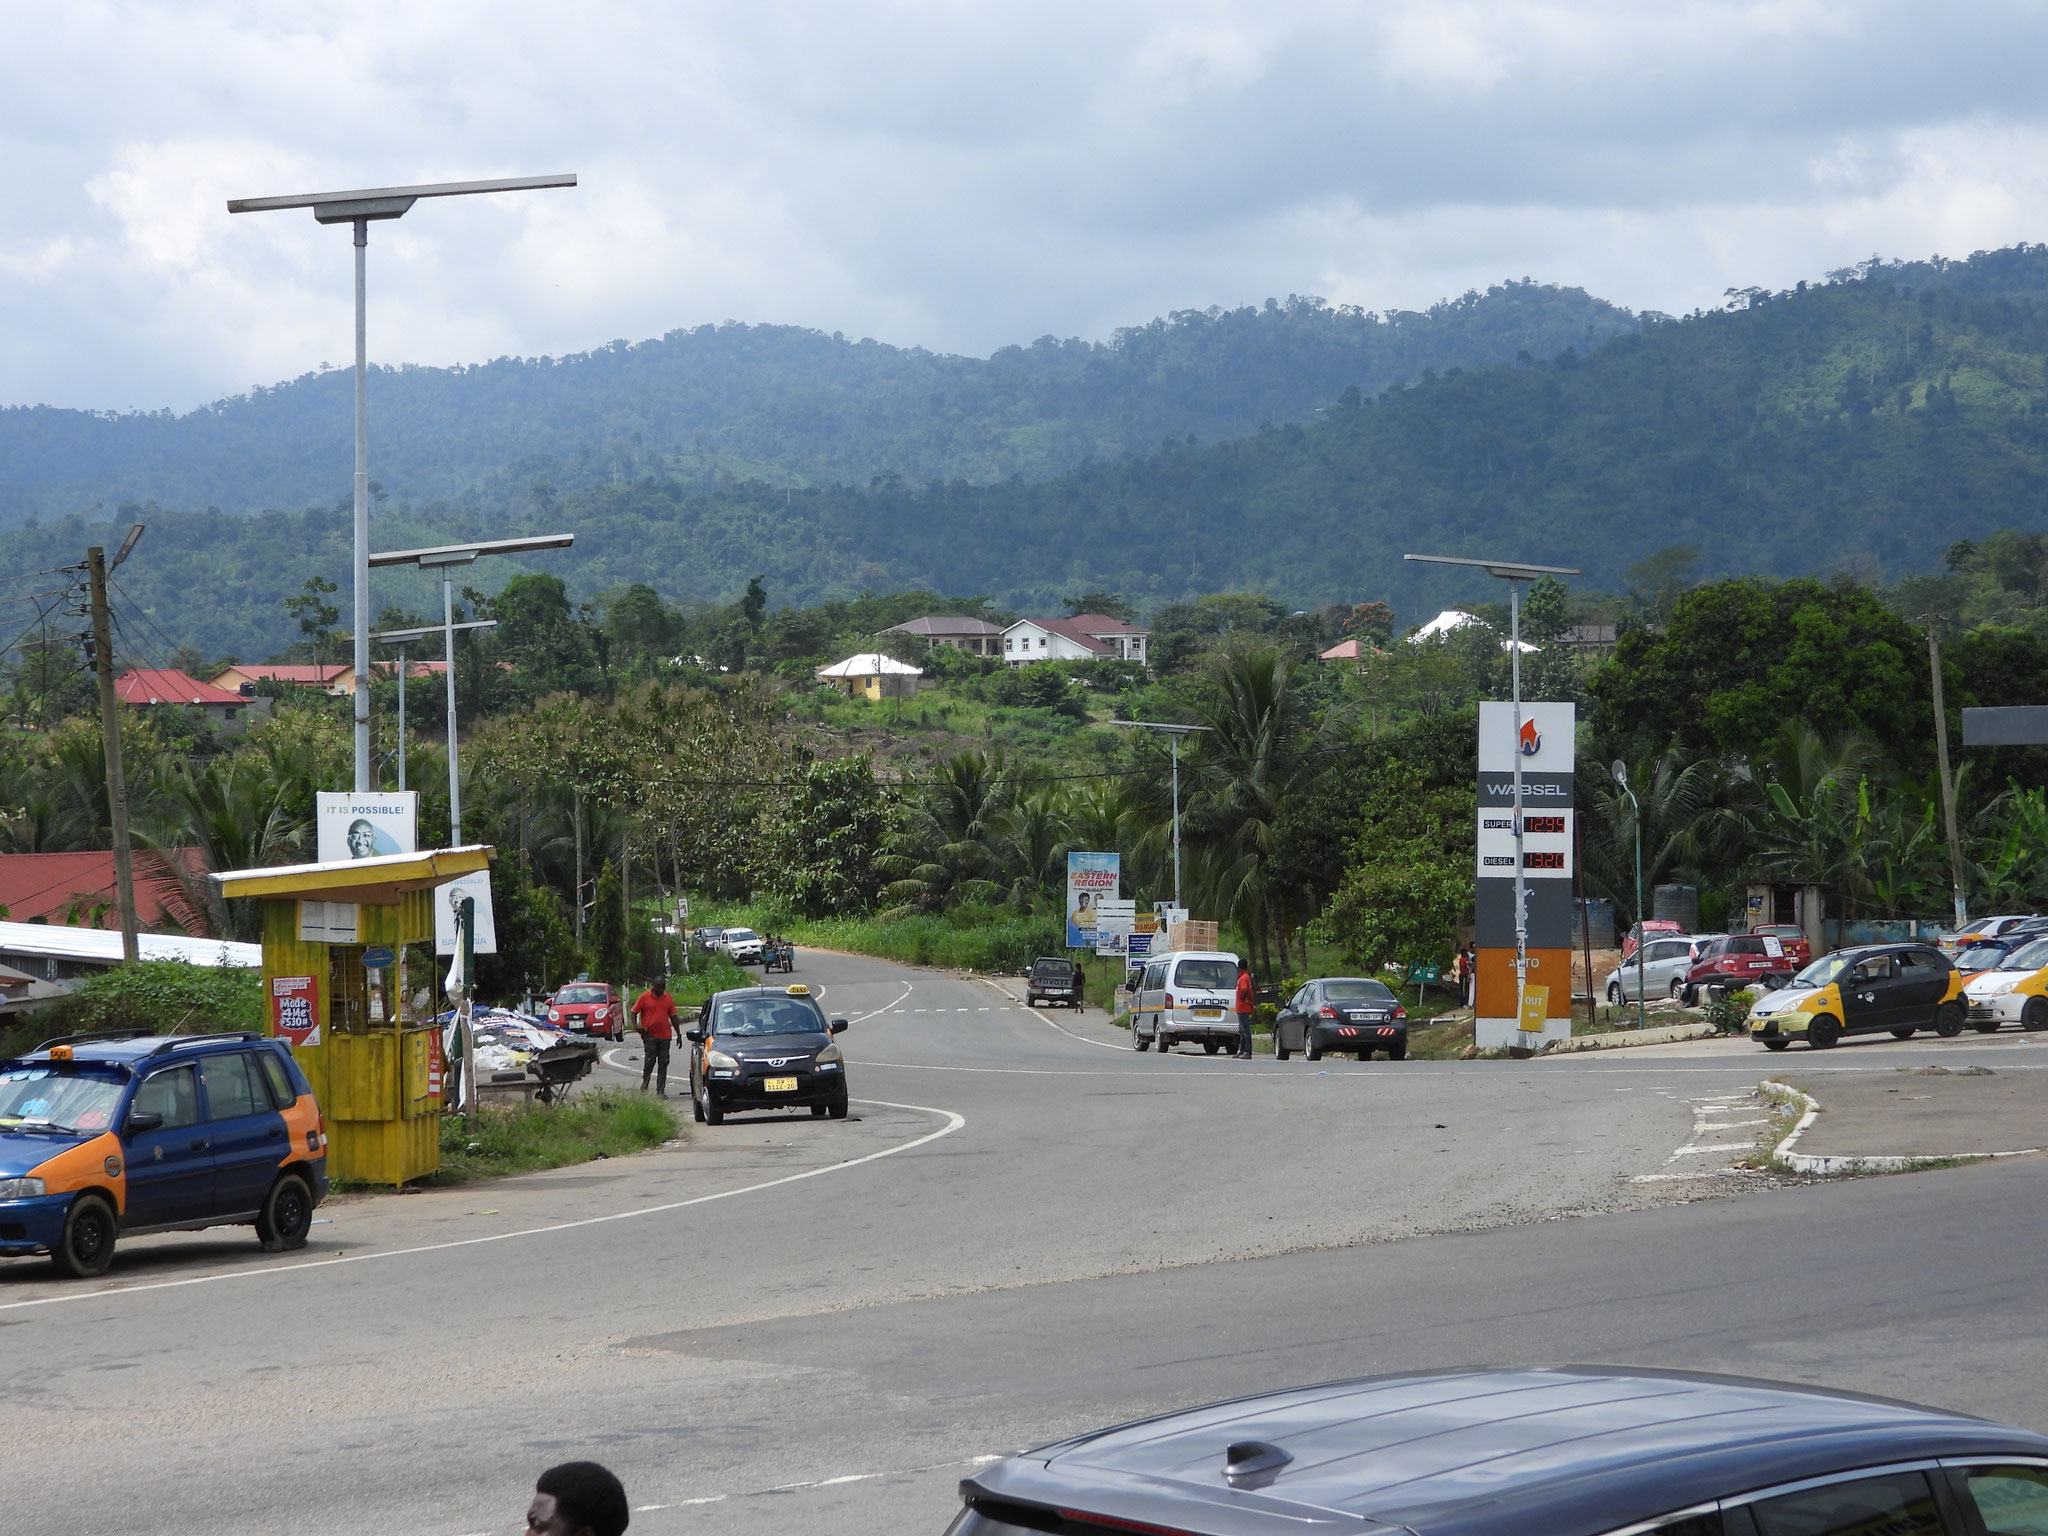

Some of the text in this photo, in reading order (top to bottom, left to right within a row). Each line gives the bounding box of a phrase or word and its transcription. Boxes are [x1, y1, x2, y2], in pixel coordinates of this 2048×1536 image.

[1487, 784, 1567, 795] WABSEL
[327, 806, 404, 814] IT IS POSSIBLE!
[1529, 818, 1565, 833] 12.95
[1070, 872, 1117, 880] EASTERN
[1509, 958, 1540, 968] ATO
[1525, 996, 1543, 1006] OUT
[282, 1008, 307, 1017] 4Me
